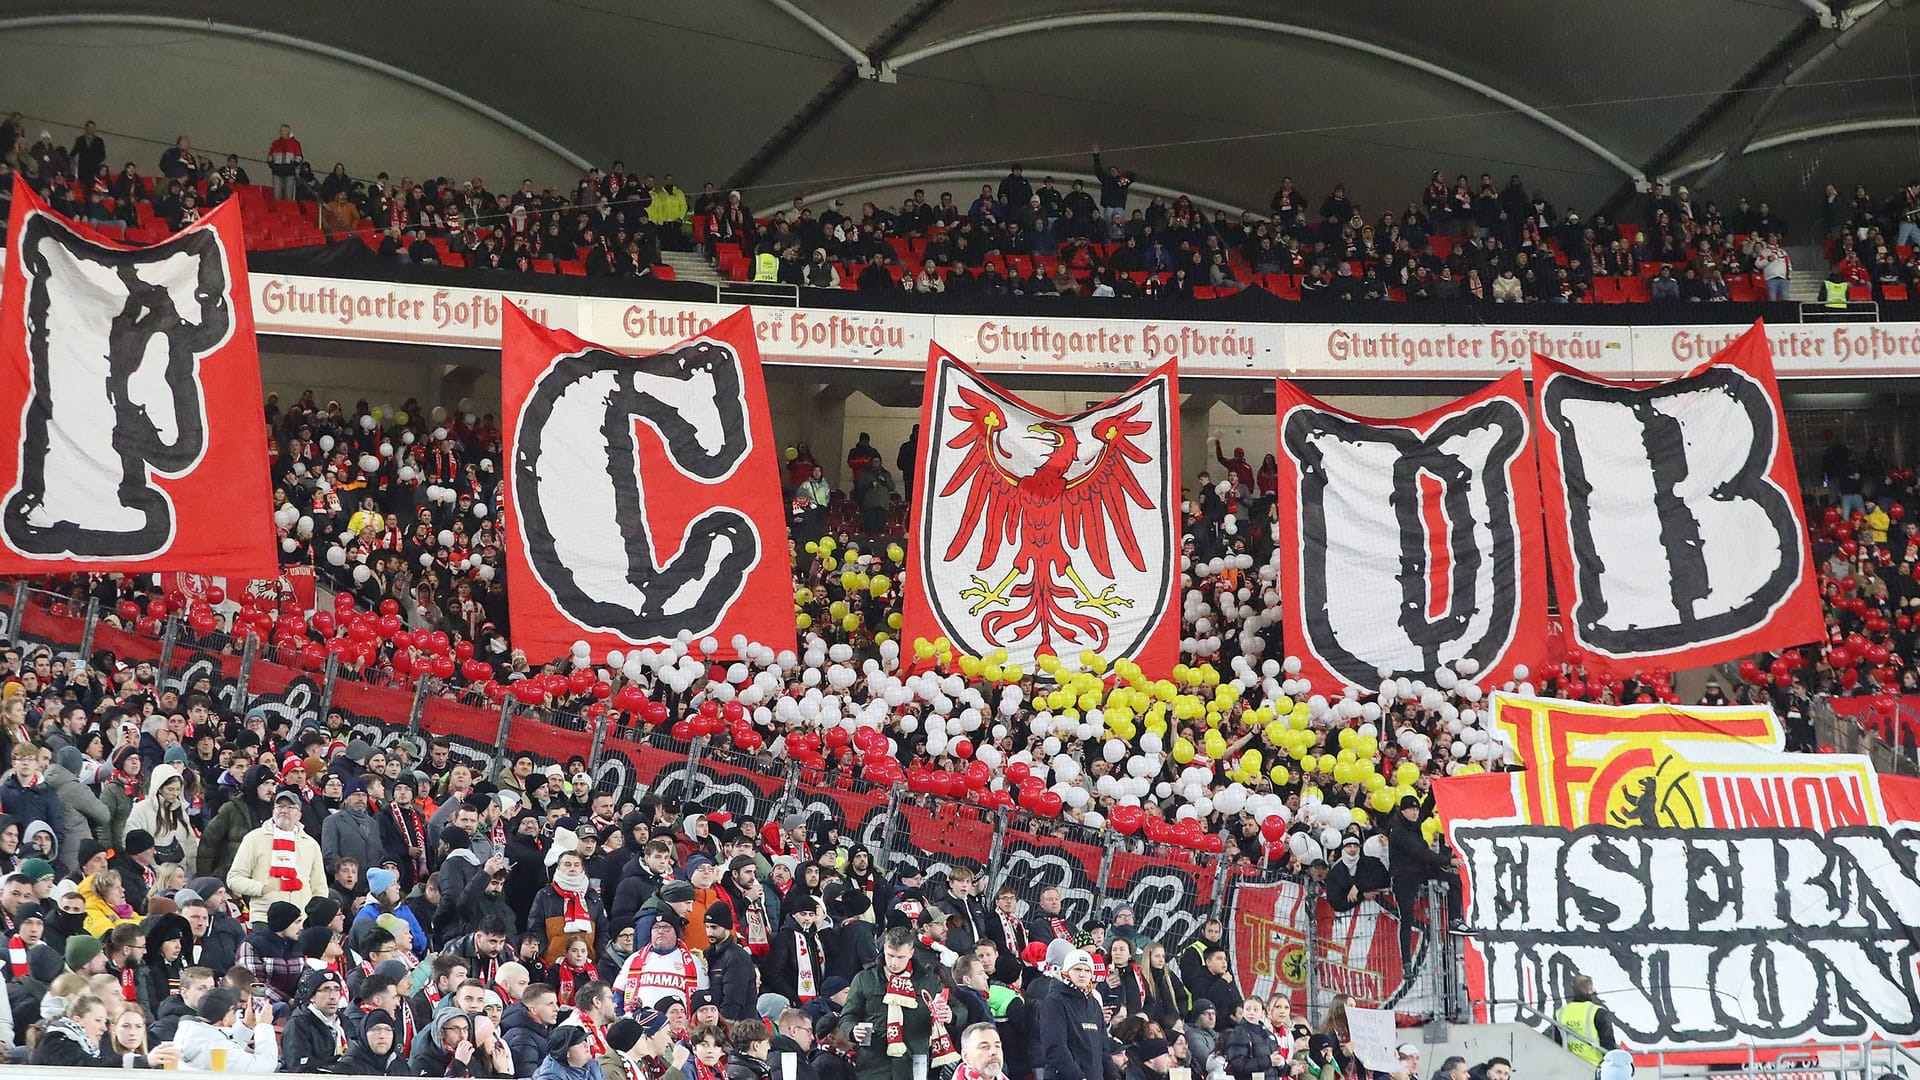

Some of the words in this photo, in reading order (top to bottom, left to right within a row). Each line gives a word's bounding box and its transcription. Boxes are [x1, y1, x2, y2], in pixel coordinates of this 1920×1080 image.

[262, 279, 424, 325] Stuttgarter
[789, 312, 904, 349] Hofbräu
[976, 320, 1135, 361] Stuttgarter
[1141, 324, 1255, 361] Hofbräu
[1327, 328, 1482, 366] Stuttgarter
[1490, 329, 1602, 365] Hofbräu
[511, 337, 761, 645] C
[1541, 363, 1804, 659] B
[1701, 774, 1866, 833] UNION
[1456, 826, 1920, 934] EISERN
[1318, 959, 1380, 1001] UNION
[1486, 937, 1916, 1044] UNION
